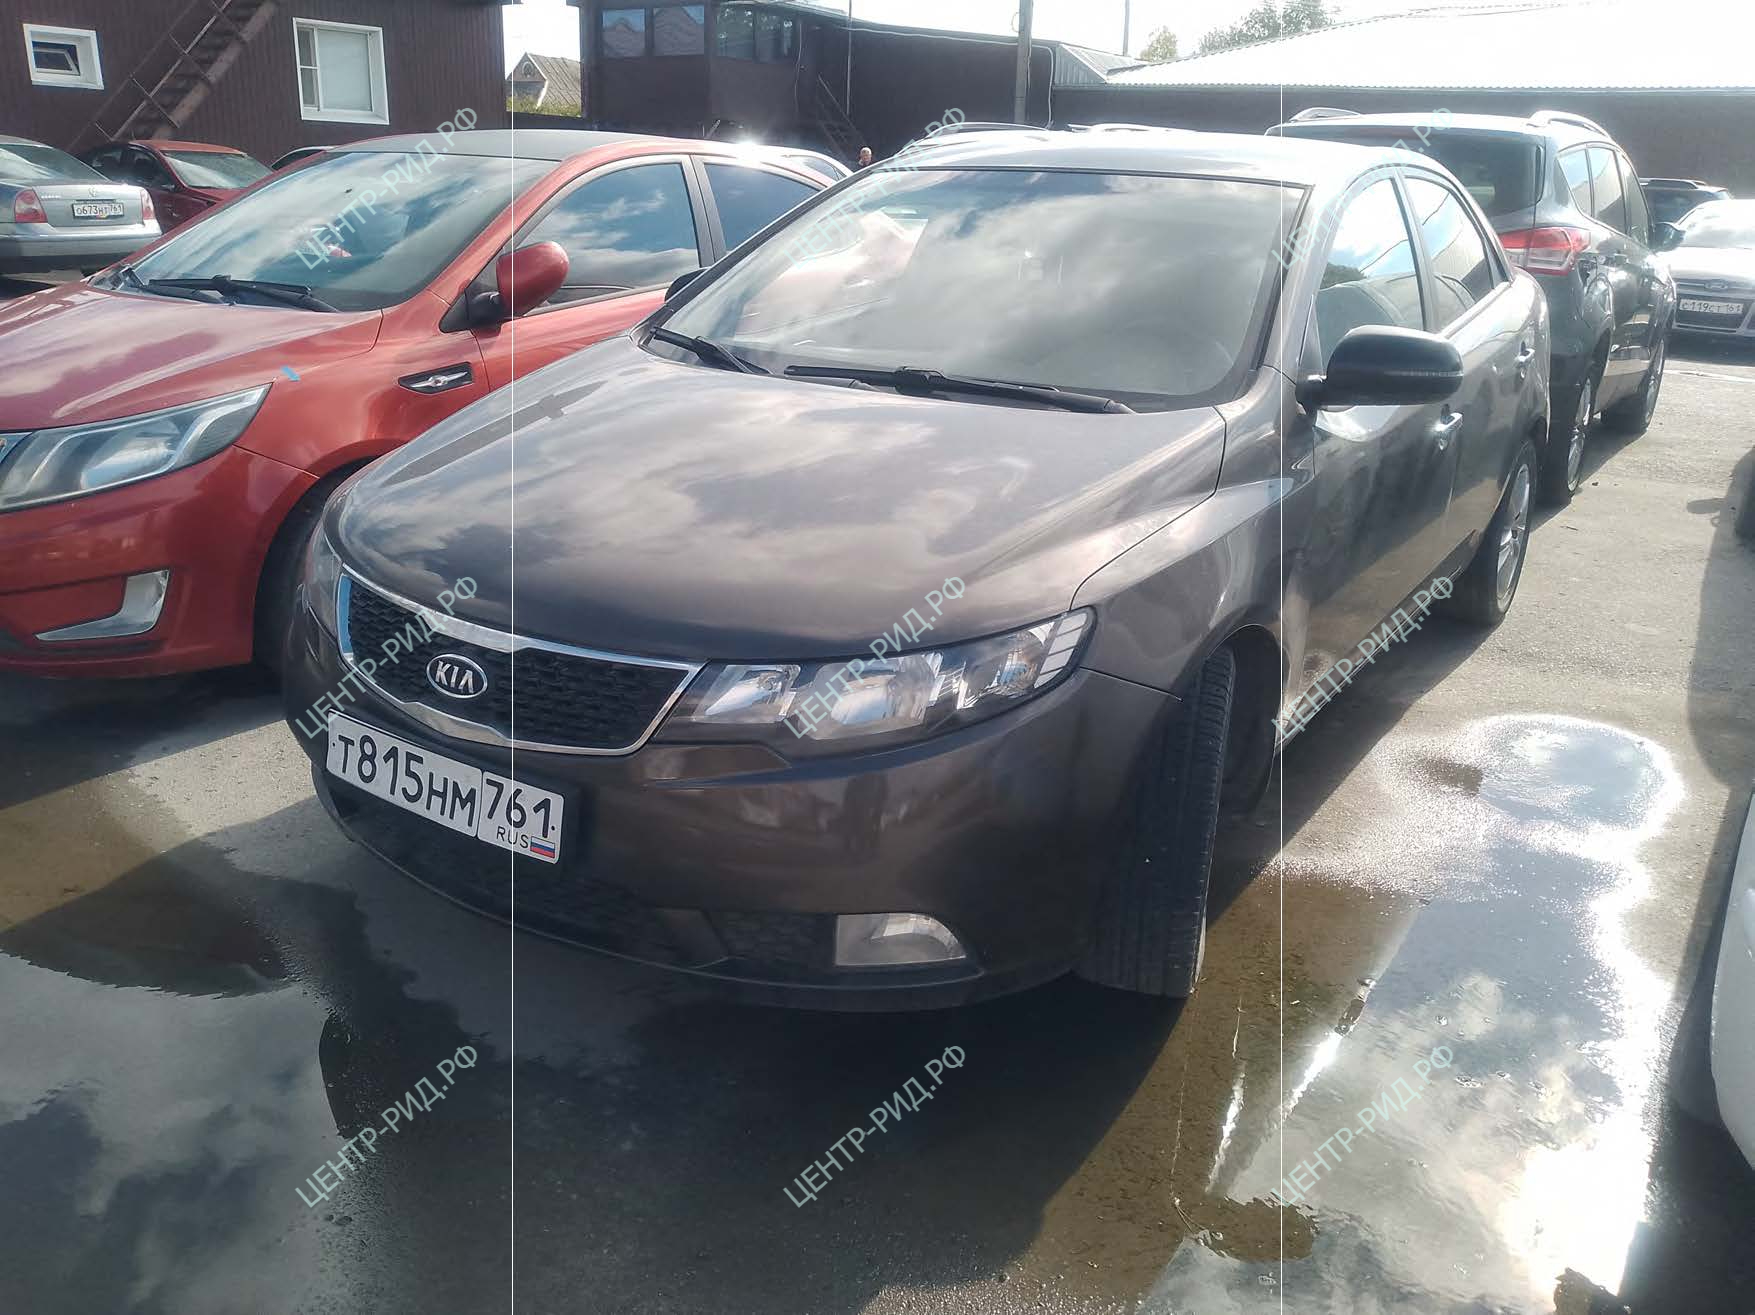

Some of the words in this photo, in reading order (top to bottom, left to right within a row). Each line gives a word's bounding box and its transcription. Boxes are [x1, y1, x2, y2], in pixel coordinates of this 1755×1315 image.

[435, 661, 474, 694] KIA
[485, 779, 553, 839] 761
[496, 825, 529, 850] RUS
